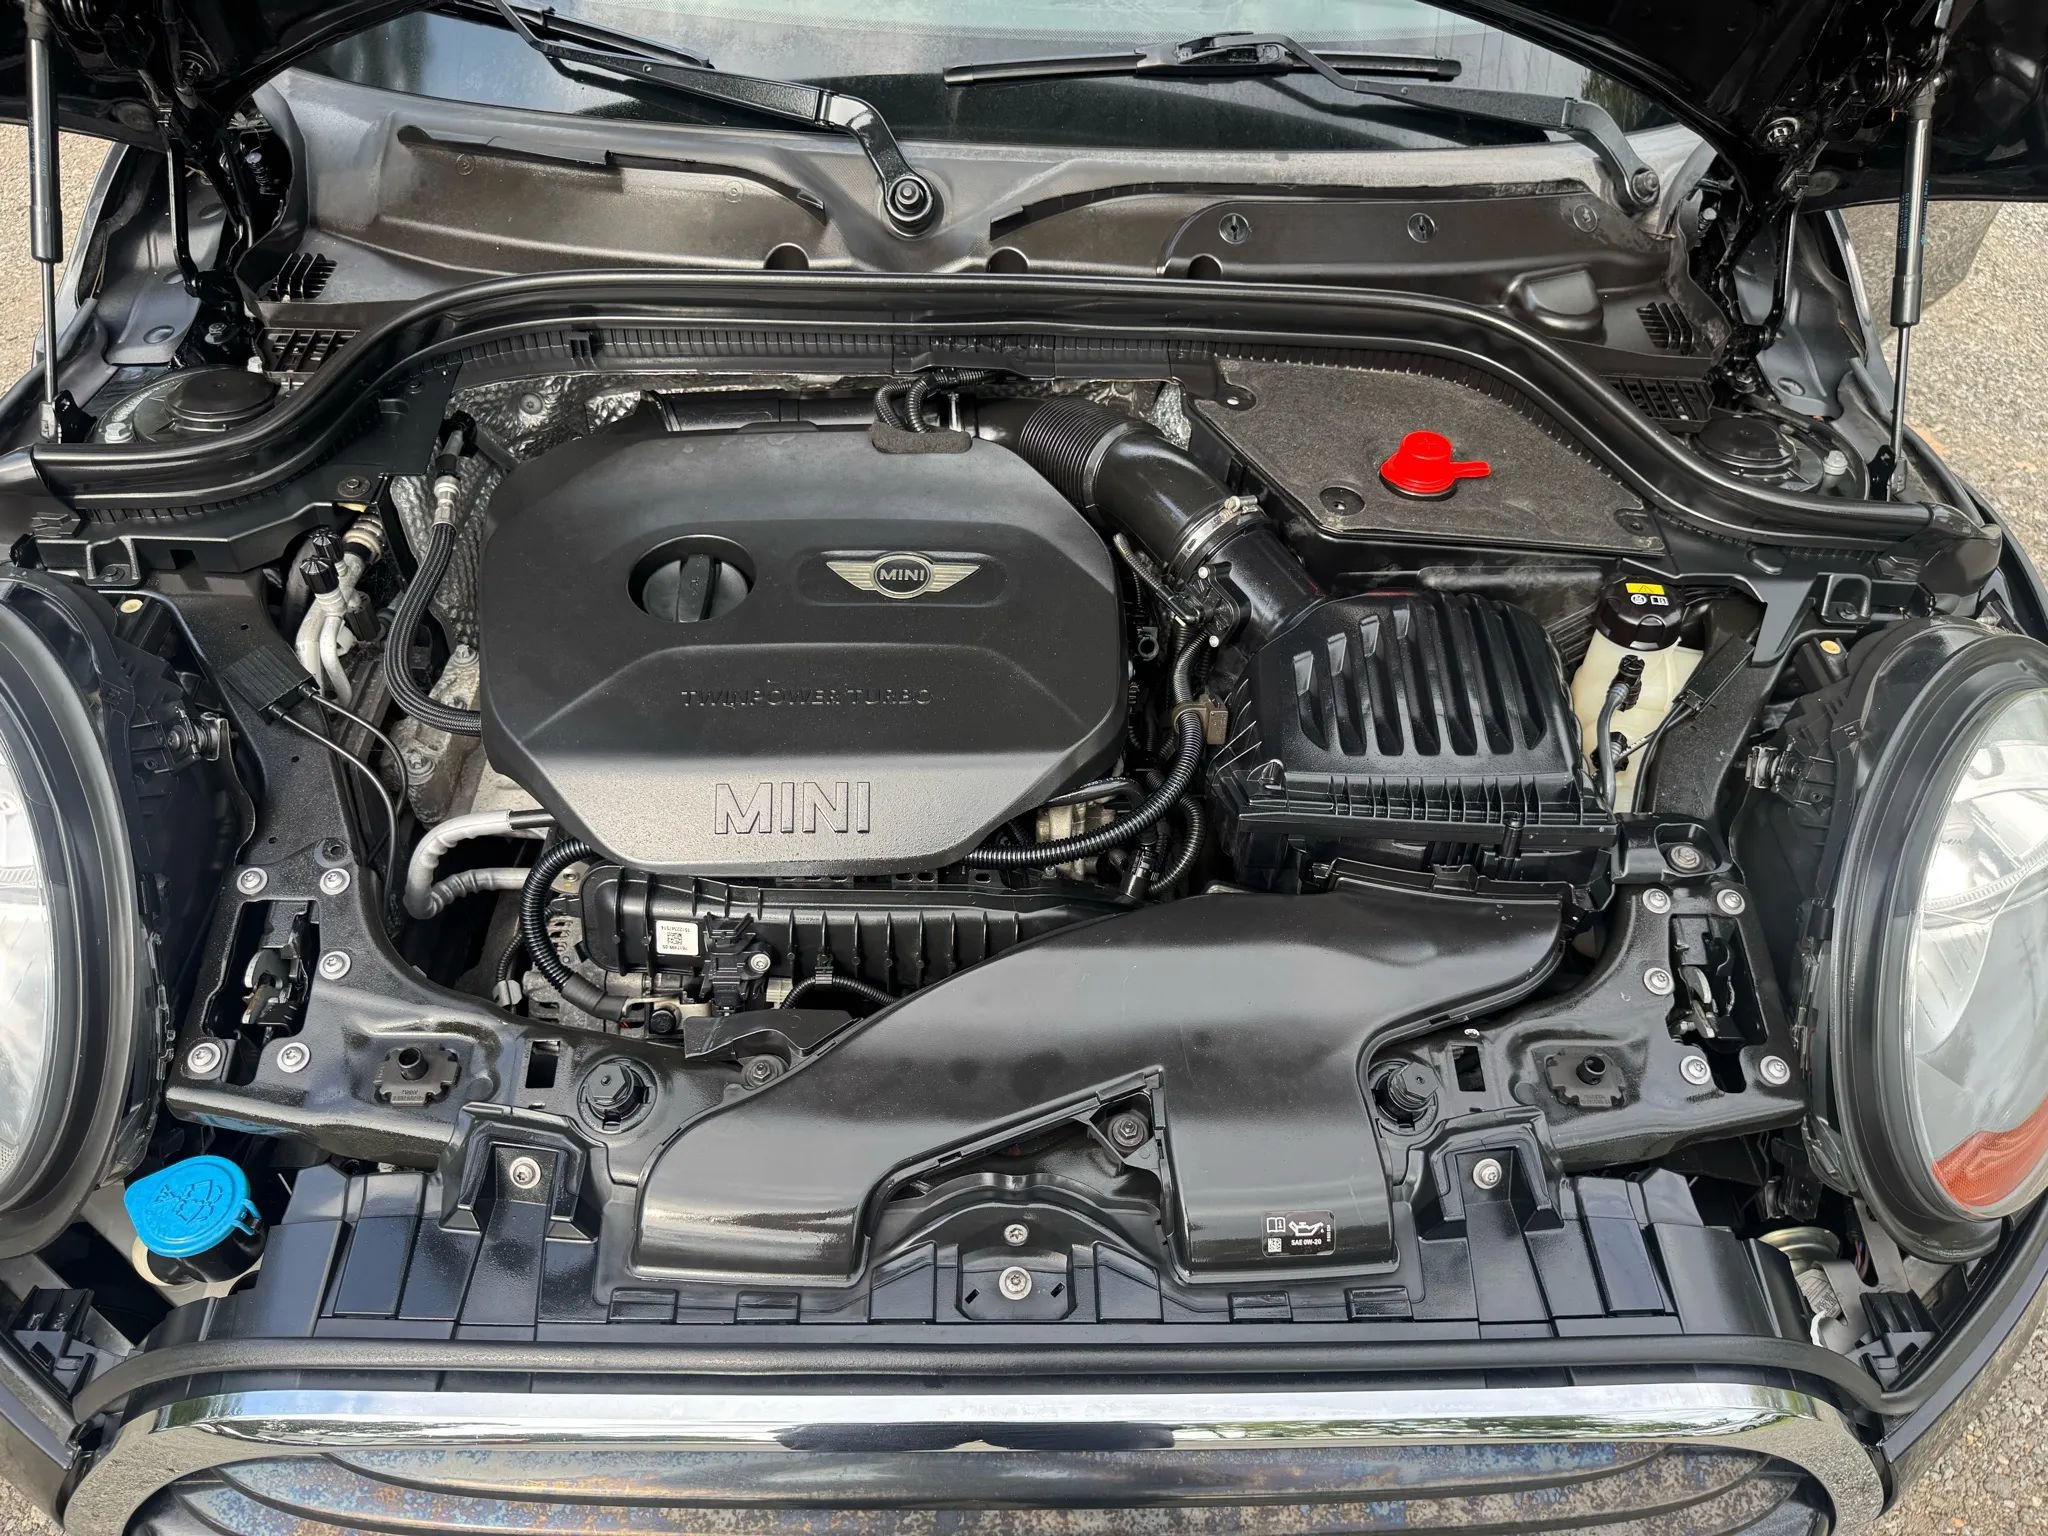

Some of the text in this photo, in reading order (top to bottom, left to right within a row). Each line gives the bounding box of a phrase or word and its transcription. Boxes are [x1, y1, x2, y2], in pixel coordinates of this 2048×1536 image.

[879, 568, 925, 581] MINI
[681, 689, 932, 706] TWINPOWER TURBO
[715, 781, 870, 834] MINI
